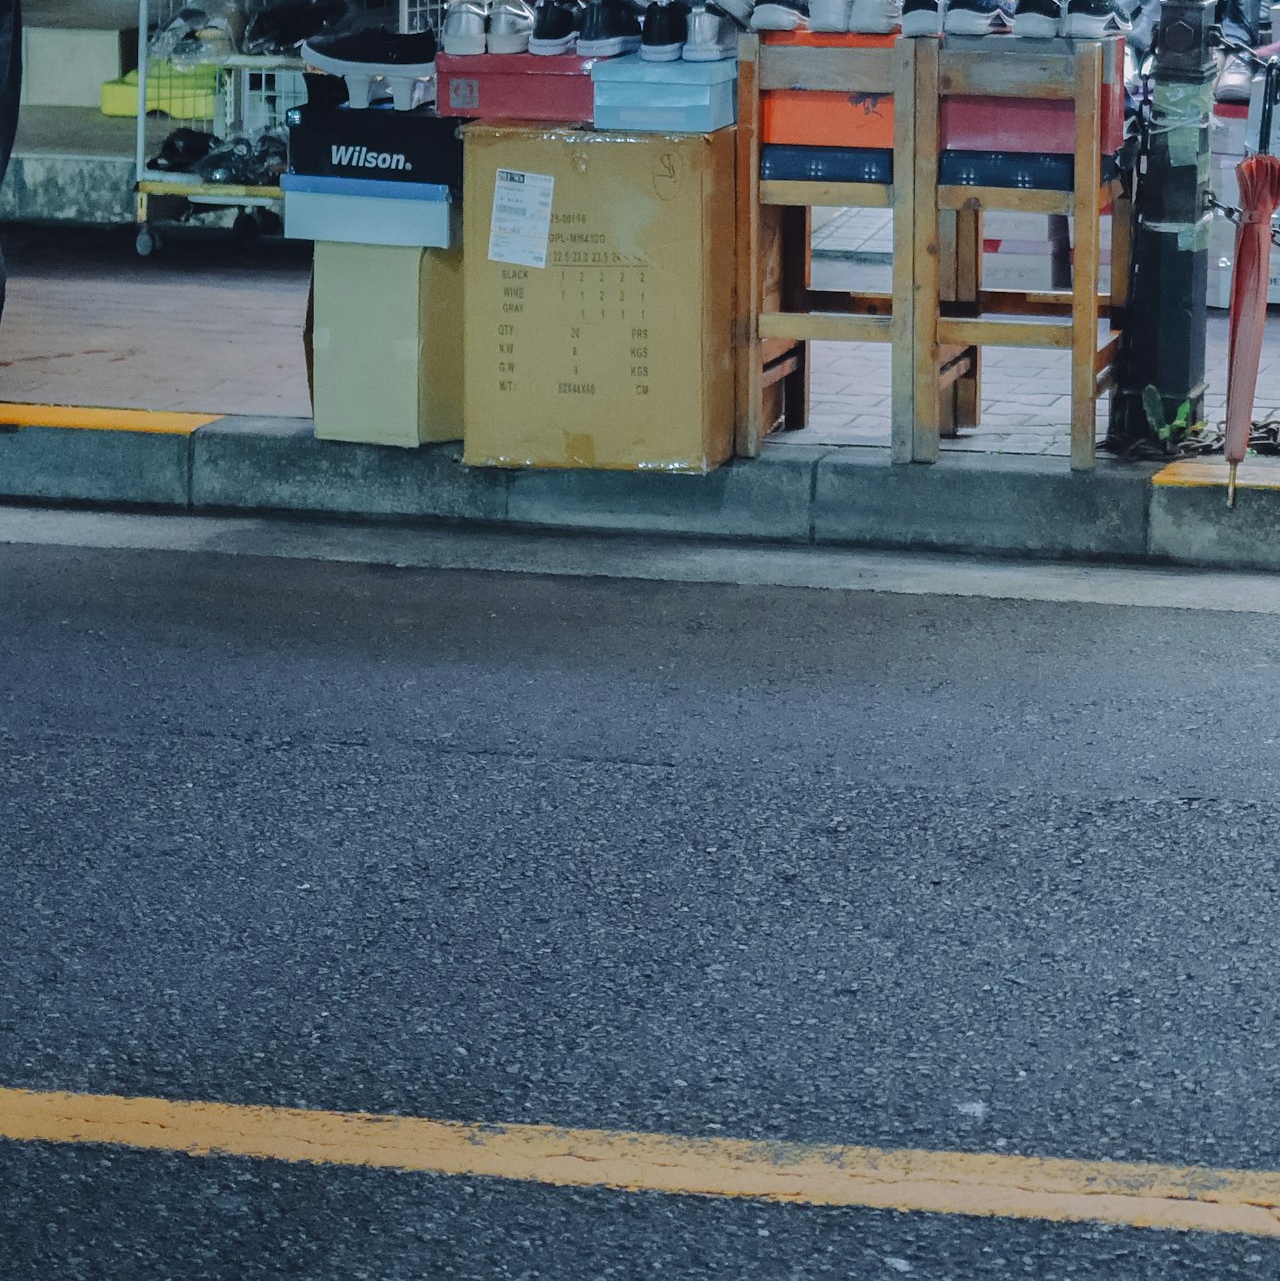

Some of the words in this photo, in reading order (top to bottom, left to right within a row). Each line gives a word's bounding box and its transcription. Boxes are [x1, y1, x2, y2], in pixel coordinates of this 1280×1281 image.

[330, 144, 406, 171] Wilson
[501, 269, 529, 280] BLACK
[503, 287, 524, 299] WINE
[502, 303, 524, 314] GRAY
[631, 328, 649, 340] PRS
[630, 347, 648, 359] KGS
[630, 365, 649, 377] KGS
[635, 384, 649, 396] CM
